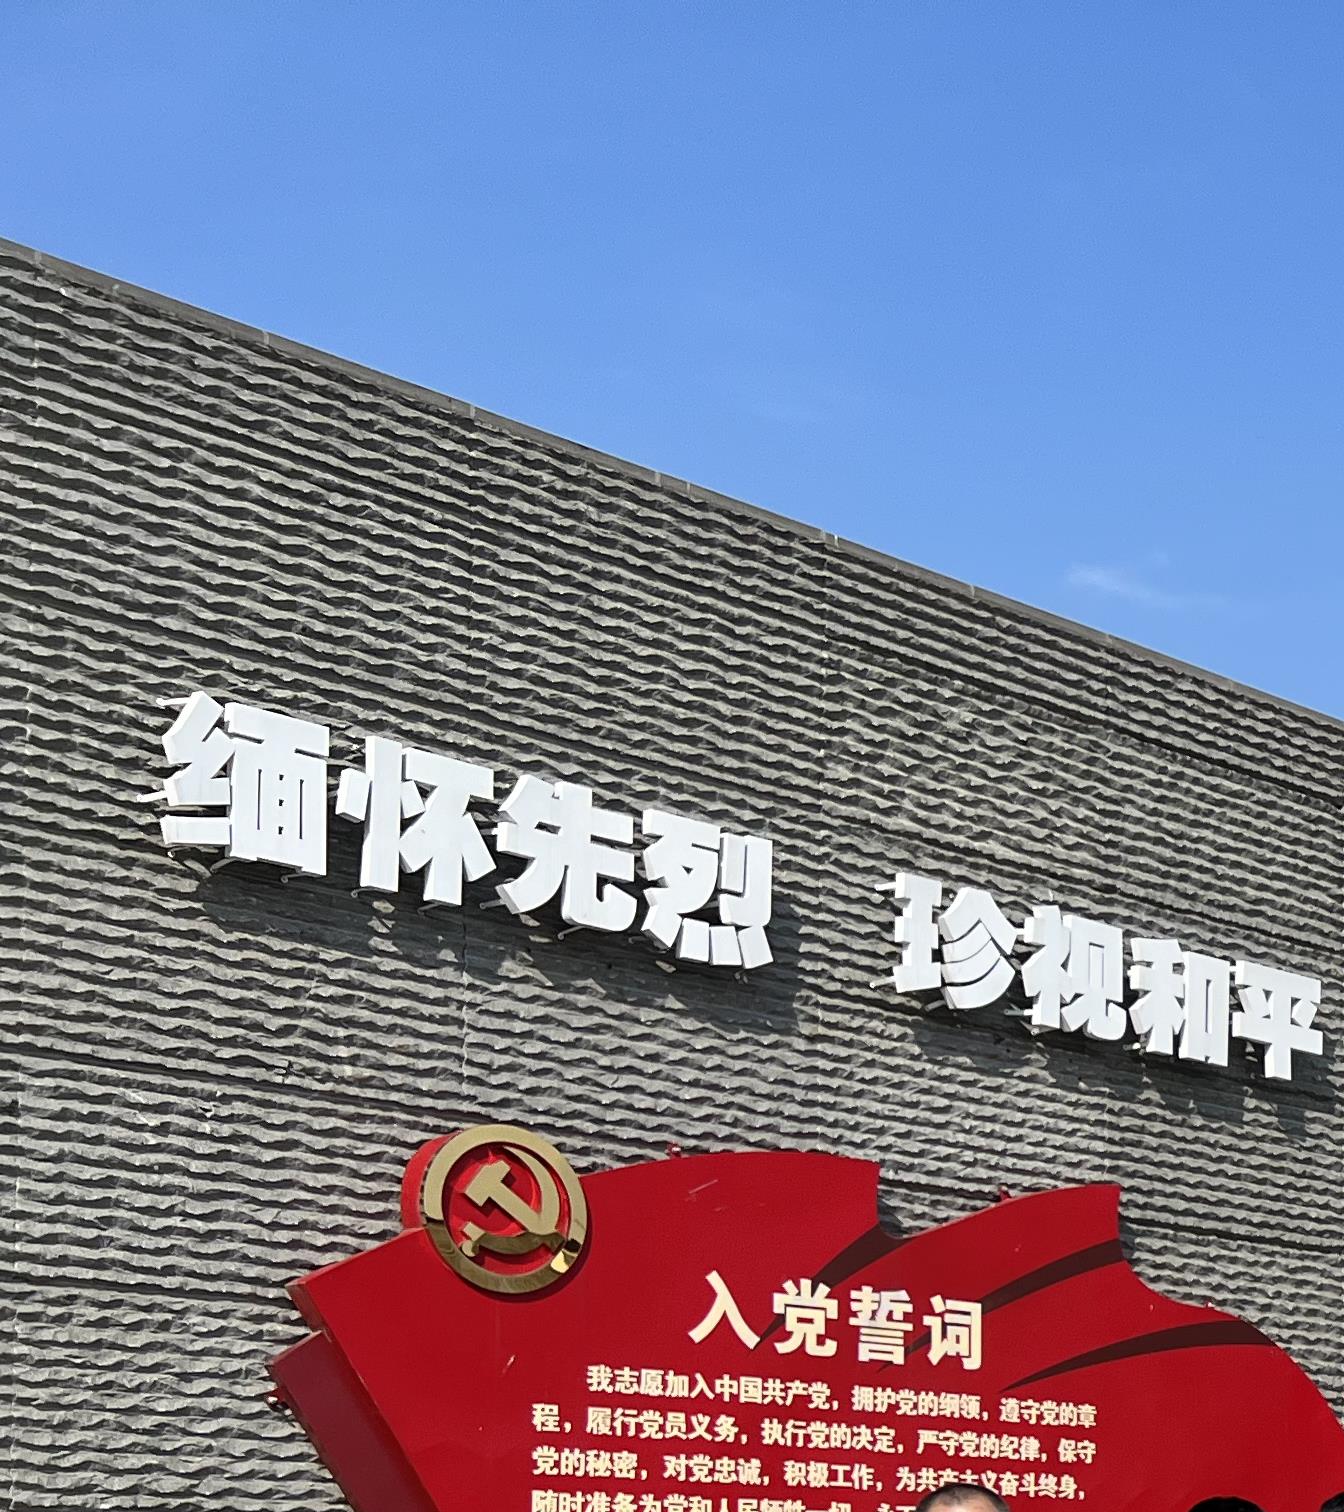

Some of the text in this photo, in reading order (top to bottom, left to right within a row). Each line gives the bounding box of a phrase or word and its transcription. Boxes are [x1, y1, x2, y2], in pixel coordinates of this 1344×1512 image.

[160, 690, 774, 970] 缅怀先烈
[893, 871, 1324, 1081] 珍视和平
[687, 1270, 983, 1371] 入党誓词
